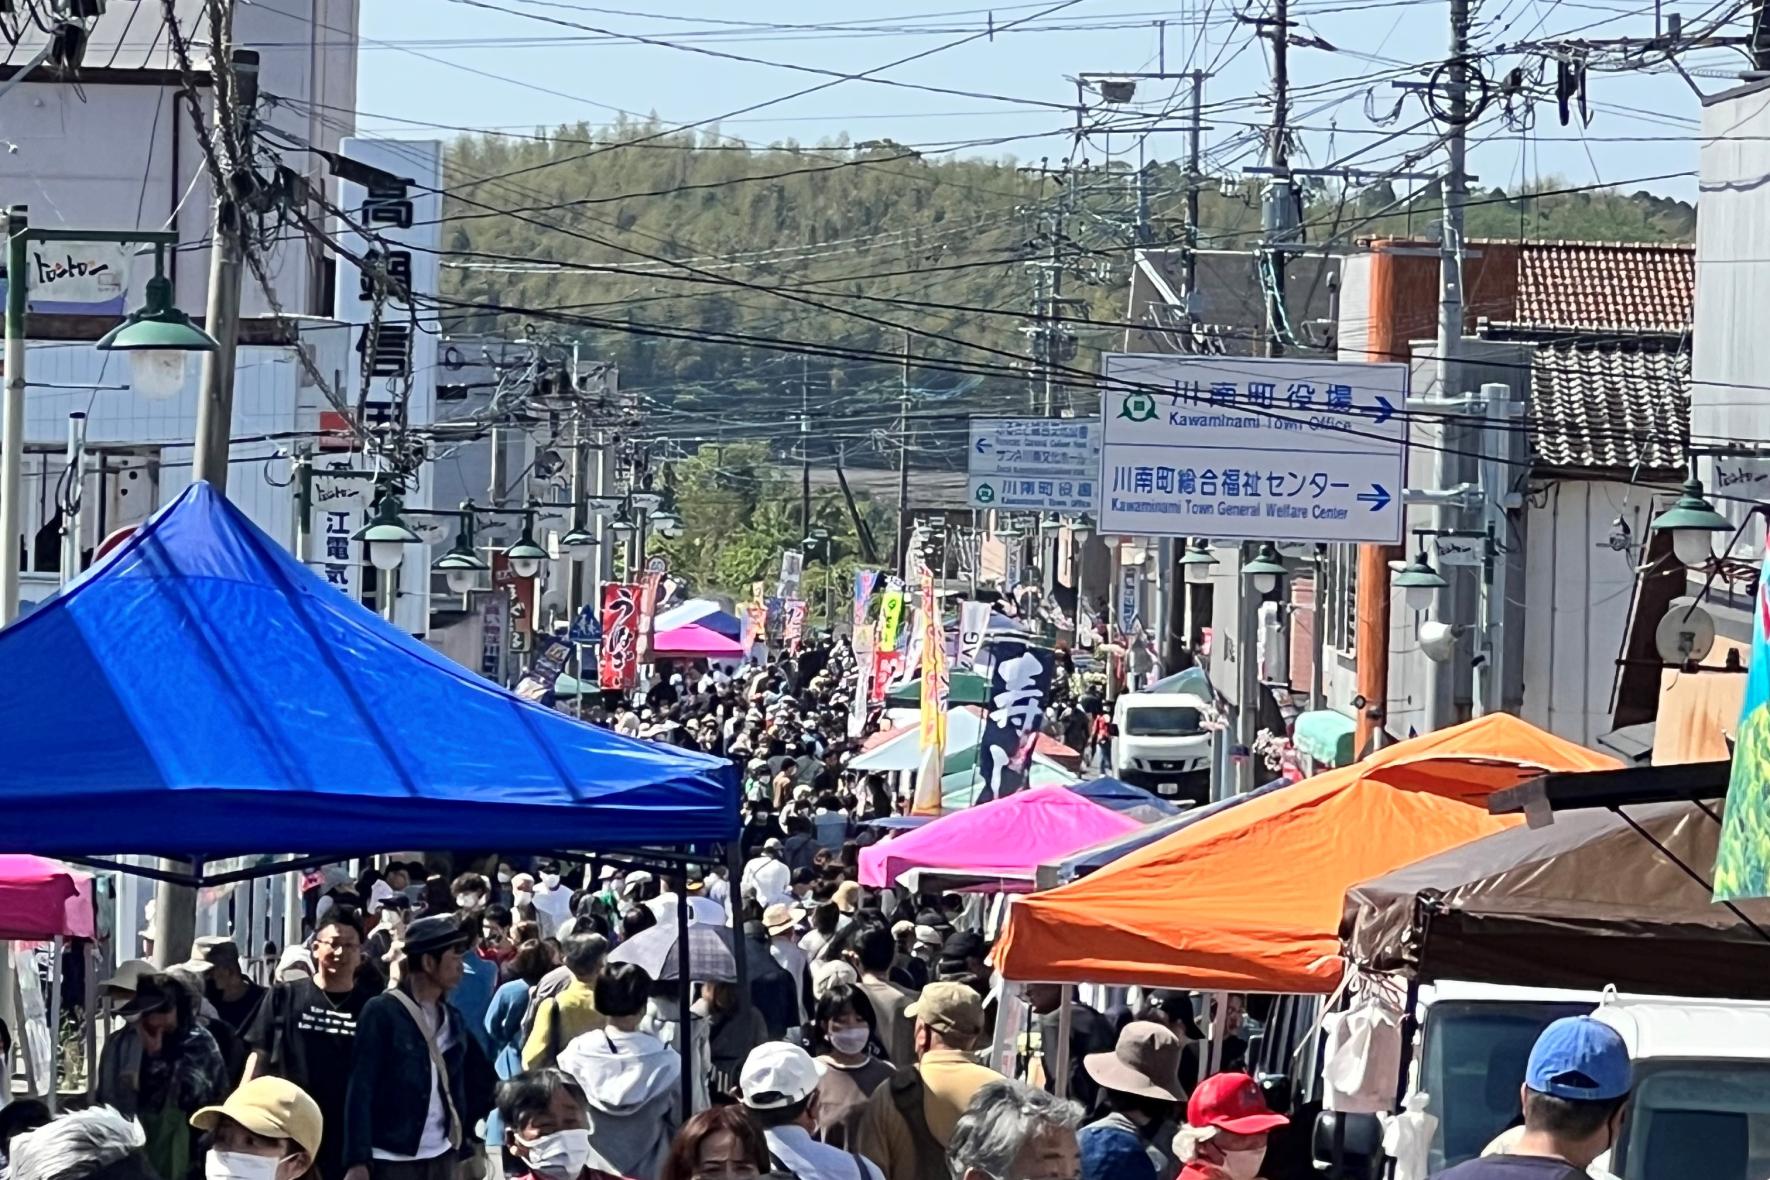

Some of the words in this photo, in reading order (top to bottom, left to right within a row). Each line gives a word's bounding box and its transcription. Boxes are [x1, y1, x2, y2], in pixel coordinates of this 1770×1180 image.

[1172, 379, 1353, 413] 川南町役場
[1169, 411, 1260, 428] Kawaminami
[1113, 466, 1350, 498] 川南町総合福祉センター
[1111, 497, 1182, 514] Kawaminami
[1185, 499, 1214, 515] Town
[1217, 501, 1261, 517] General
[1266, 502, 1308, 519] Welfare
[1312, 504, 1349, 520] Center
